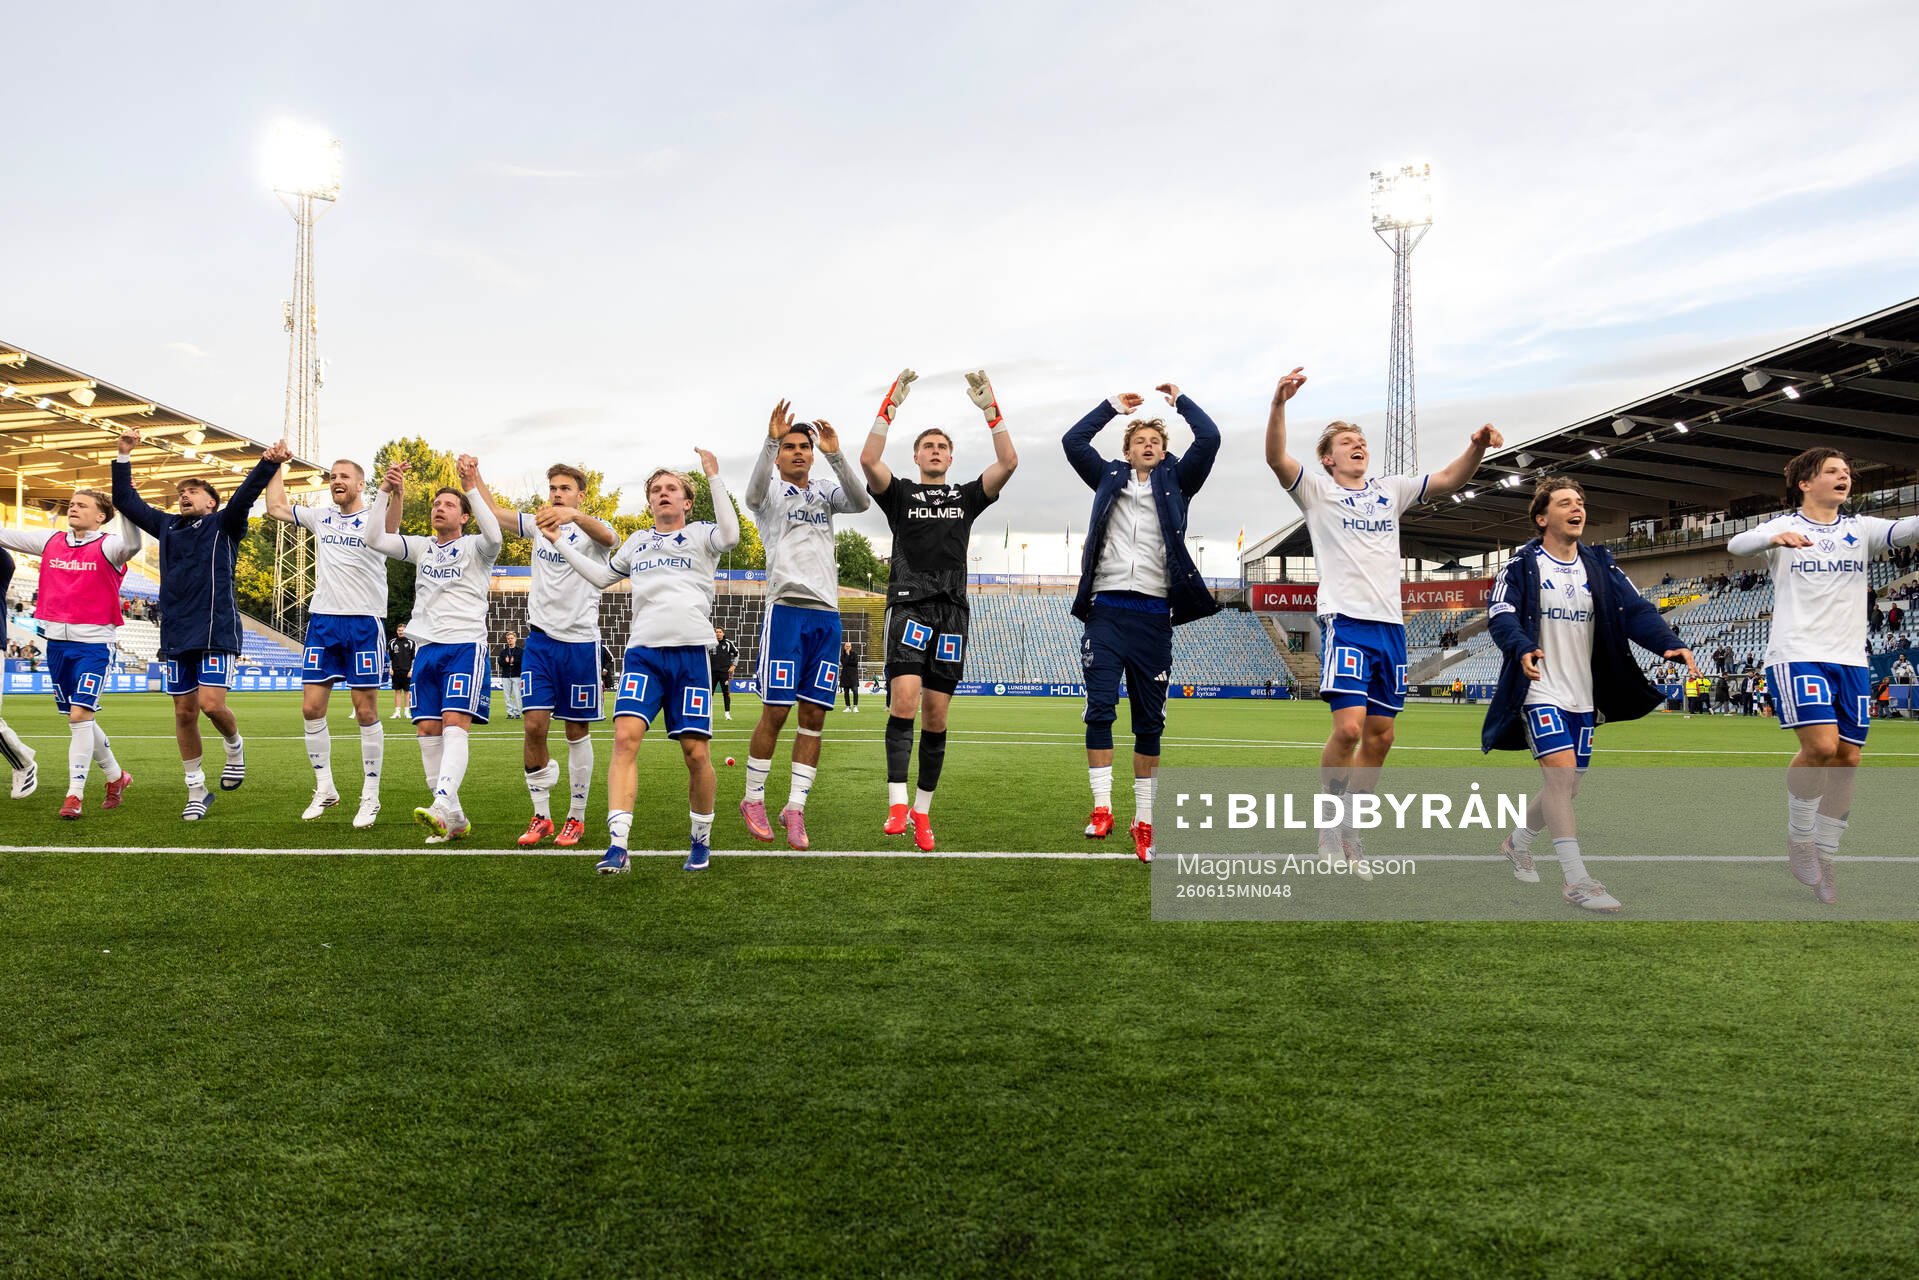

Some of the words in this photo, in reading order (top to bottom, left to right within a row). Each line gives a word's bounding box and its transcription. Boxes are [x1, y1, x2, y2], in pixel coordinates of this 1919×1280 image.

[908, 508, 964, 519] HOLMEN
[49, 557, 97, 571] stadium
[632, 558, 692, 574] HOLMEN
[1791, 560, 1864, 573] HOLMEN
[1264, 594, 1288, 605] ICA
